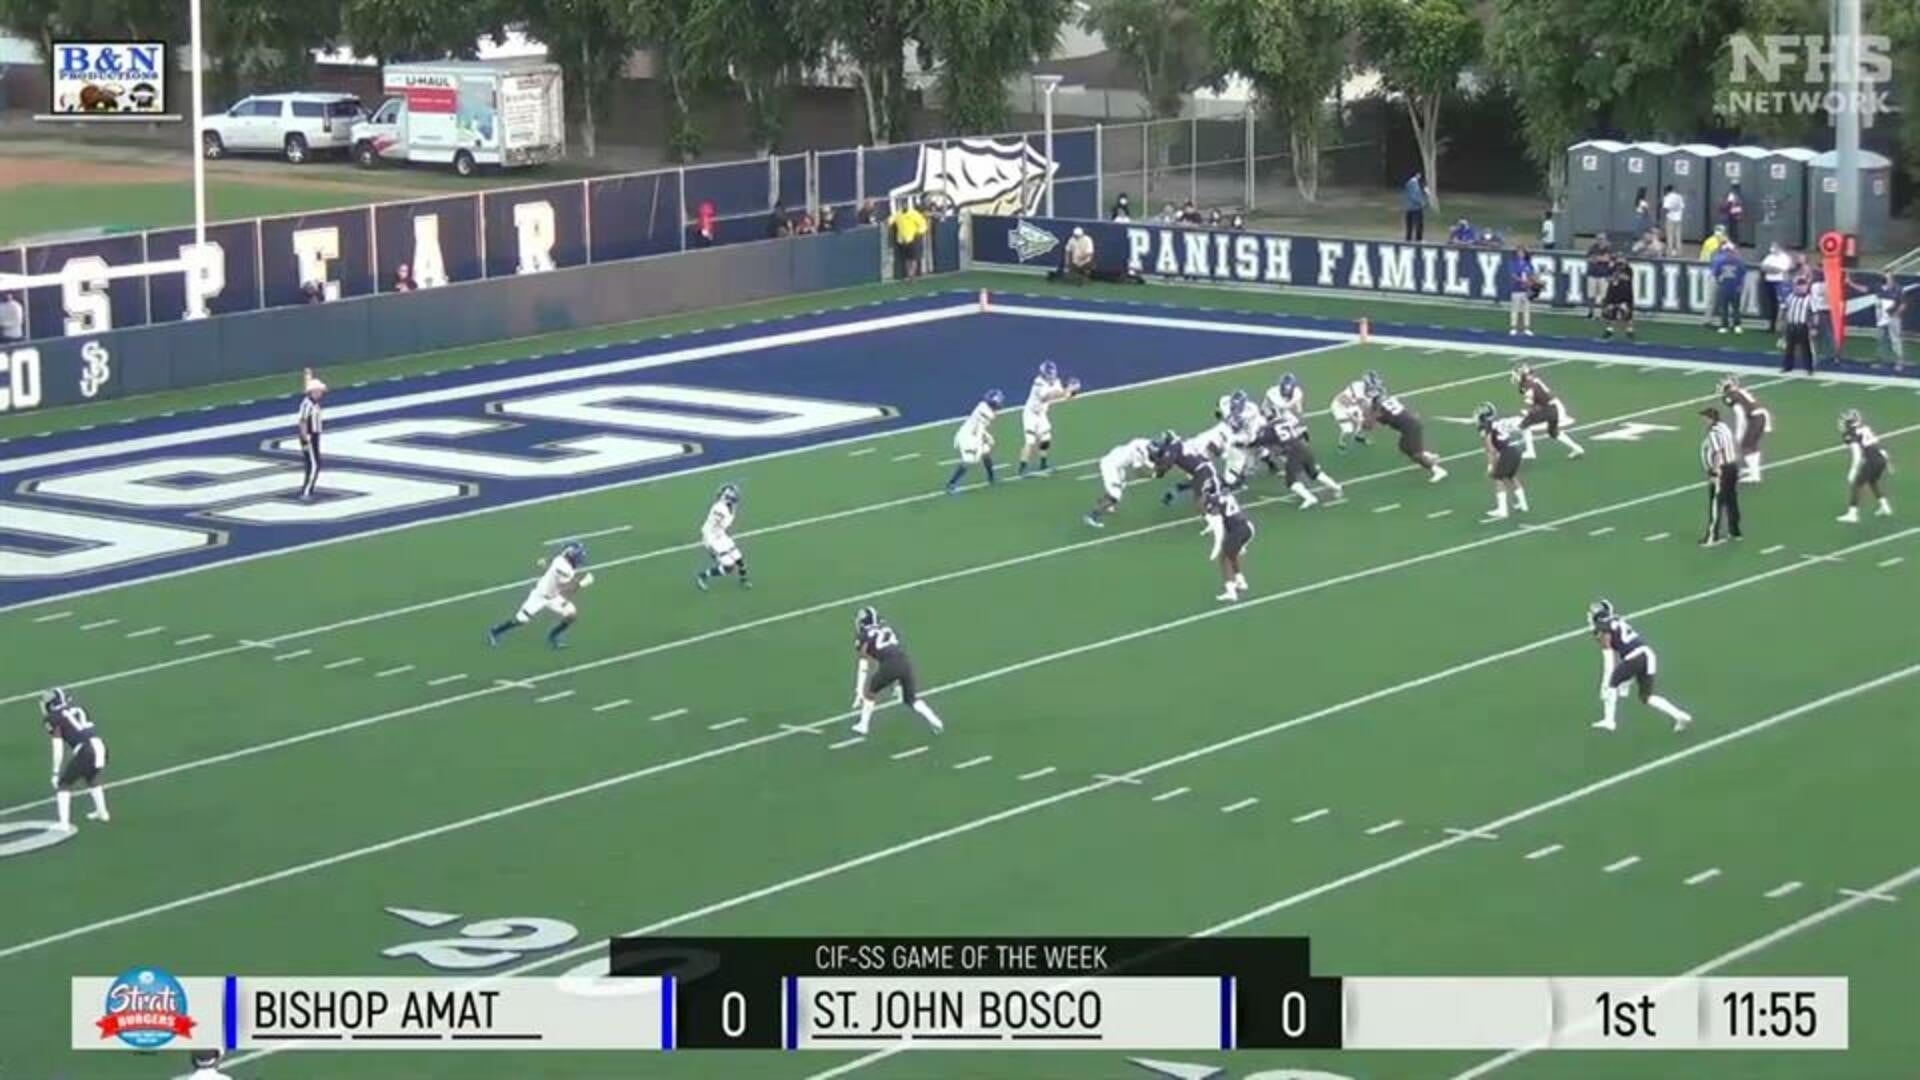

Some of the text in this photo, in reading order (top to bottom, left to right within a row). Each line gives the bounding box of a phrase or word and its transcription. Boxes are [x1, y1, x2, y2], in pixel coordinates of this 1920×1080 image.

[405, 75, 450, 88] U-HAUL
[1127, 227, 1292, 284] PANISH
[1317, 241, 1502, 298] FAMILY
[61, 706, 96, 732] 12
